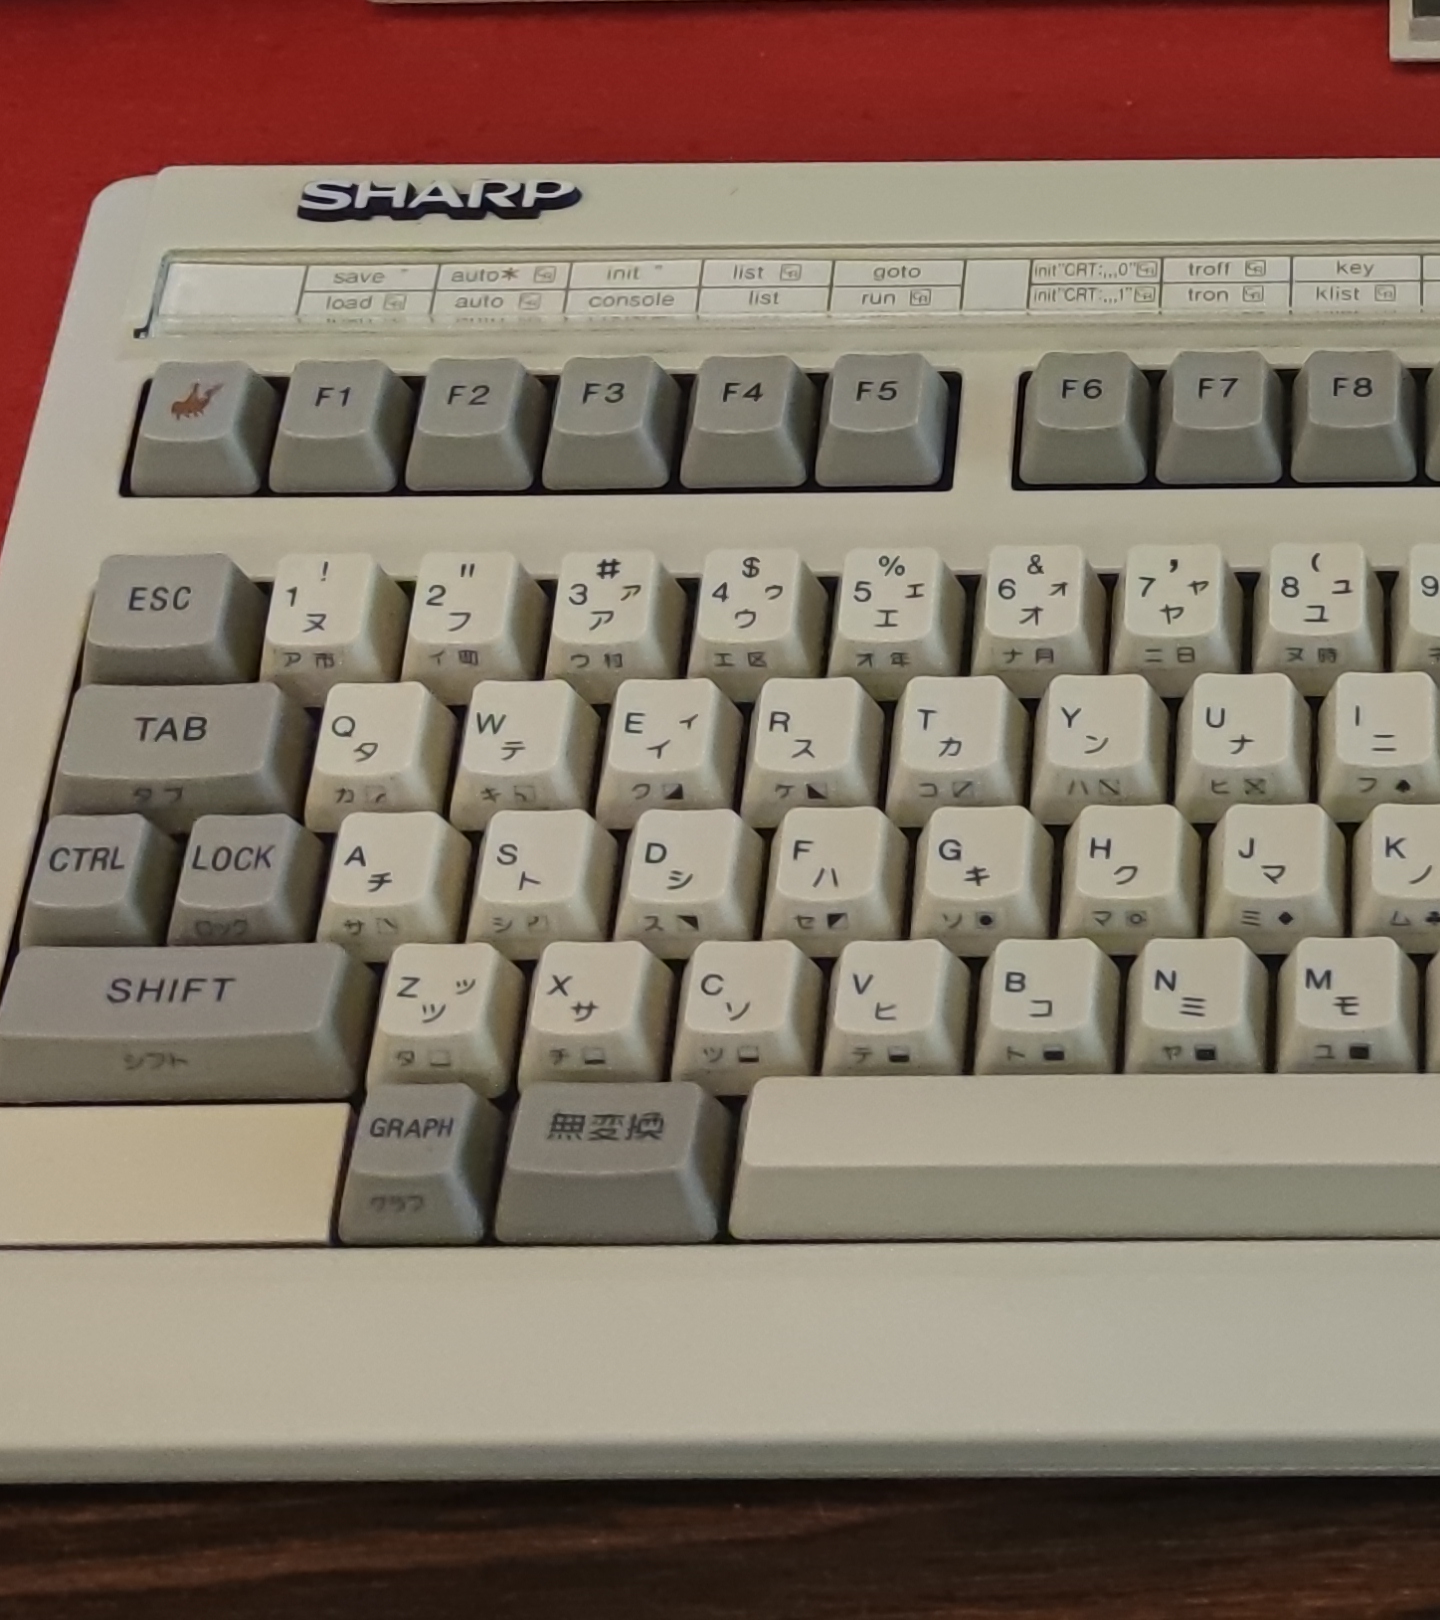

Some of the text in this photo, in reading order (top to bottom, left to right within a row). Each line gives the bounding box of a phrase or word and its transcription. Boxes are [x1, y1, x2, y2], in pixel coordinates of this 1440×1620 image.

[298, 178, 582, 222] SHARP
[333, 271, 386, 285] save
[606, 266, 640, 280] init
[731, 261, 765, 279] list
[872, 262, 923, 284] goto
[1188, 261, 1230, 276] troff
[1336, 260, 1374, 278] key
[325, 295, 373, 310] load
[454, 294, 505, 309] auto
[587, 291, 675, 308] console
[748, 289, 780, 306] list
[861, 293, 896, 305] run
[1187, 288, 1229, 302] tron
[1315, 286, 1360, 301] klist
[314, 386, 351, 407] F1
[447, 384, 491, 406] F2
[582, 382, 625, 404] F3
[722, 382, 763, 403] F4
[856, 380, 898, 401] F5
[1061, 378, 1103, 400] F6
[1198, 377, 1239, 399] F7
[1332, 376, 1373, 398] F8
[287, 586, 298, 607] 1
[425, 584, 447, 607] 2
[568, 583, 588, 606] 3
[711, 581, 729, 603] 4
[853, 580, 872, 603] 5
[997, 578, 1017, 601] 6
[1138, 576, 1157, 598] 7
[1280, 575, 1300, 599] 8
[1420, 575, 1440, 598] 9
[128, 585, 192, 612] ESC
[331, 715, 356, 738] Q
[476, 712, 507, 735] W
[624, 712, 645, 735] E
[768, 710, 791, 733] R
[917, 708, 937, 731] T
[1061, 706, 1082, 729] Y
[1205, 706, 1226, 729] U
[1354, 705, 1361, 727] I
[134, 716, 208, 742] TAB
[191, 842, 274, 873] LOCK
[344, 845, 367, 867] A
[496, 843, 518, 866] S
[644, 842, 668, 865] D
[792, 839, 814, 861] F
[938, 838, 962, 861] G
[1089, 837, 1112, 860] H
[1238, 837, 1255, 859] J
[1385, 836, 1406, 859] K
[47, 845, 125, 874] CTRL
[396, 976, 421, 999] Z
[547, 974, 572, 997] X
[700, 973, 724, 996] C
[852, 973, 874, 995] V
[1004, 971, 1027, 993] B
[1154, 969, 1177, 992] N
[1305, 967, 1332, 990] M
[106, 977, 236, 1004] SHIFT
[369, 1117, 455, 1139] GRAPH
[546, 1111, 665, 1142] 無変換
